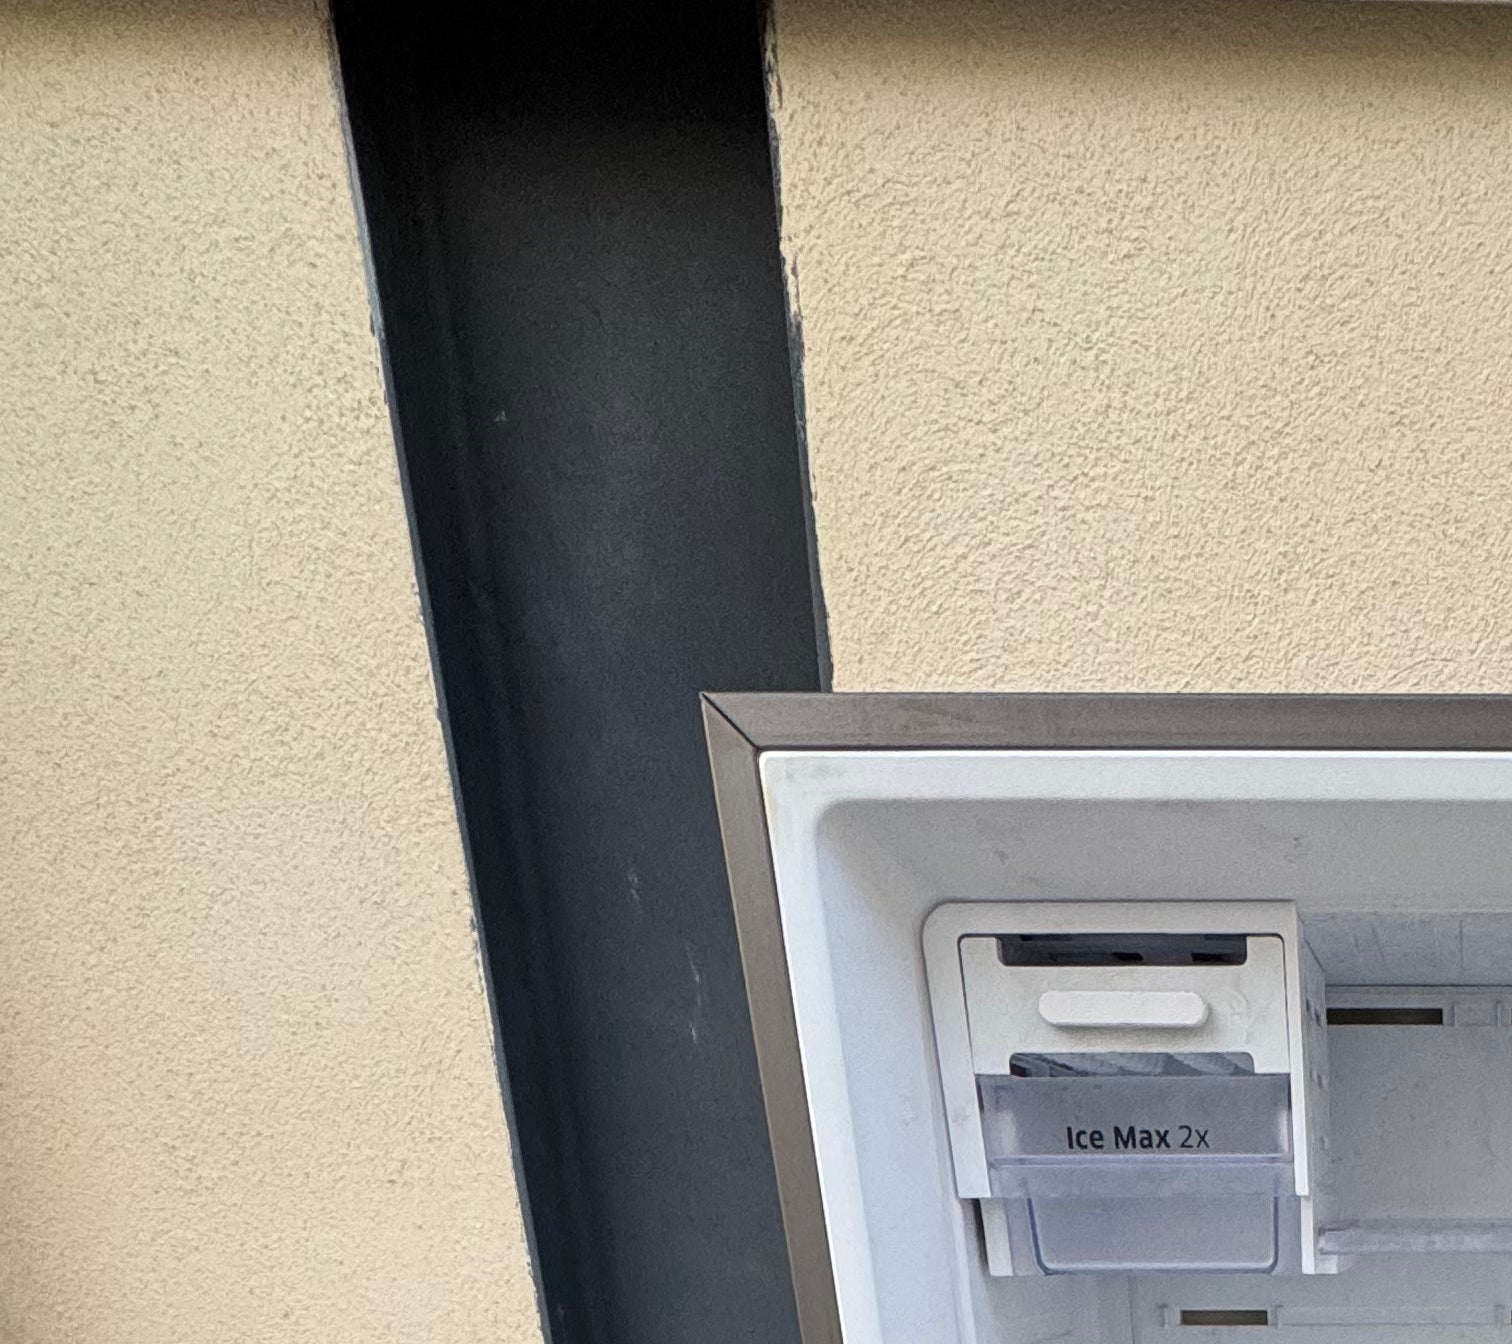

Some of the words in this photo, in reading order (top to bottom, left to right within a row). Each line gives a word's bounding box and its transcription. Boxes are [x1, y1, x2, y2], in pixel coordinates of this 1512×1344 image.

[1066, 1126, 1105, 1150] Ice
[1112, 1125, 1171, 1150] Max
[1178, 1125, 1210, 1149] 2x
